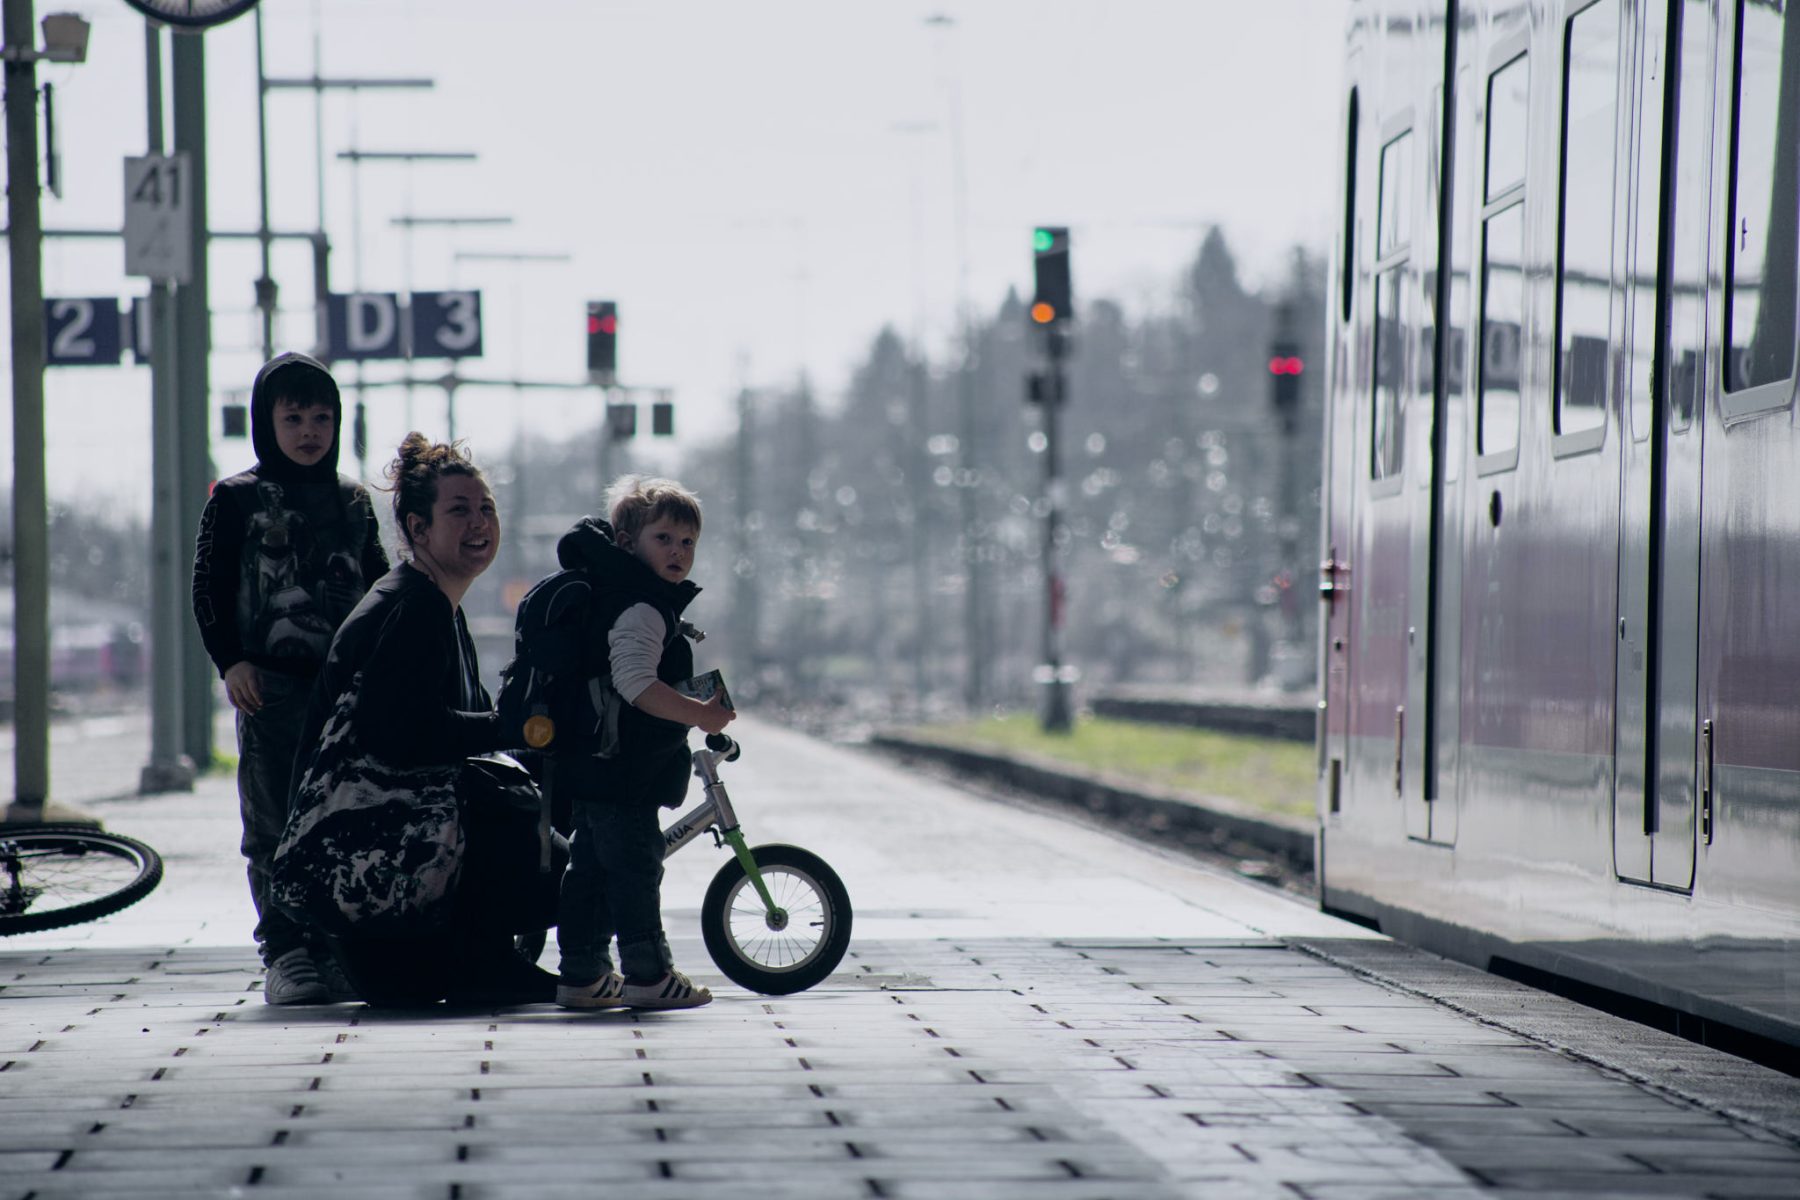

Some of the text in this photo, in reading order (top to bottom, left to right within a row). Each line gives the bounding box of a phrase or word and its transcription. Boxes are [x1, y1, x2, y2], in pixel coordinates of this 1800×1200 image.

[132, 162, 180, 210] 41
[52, 299, 96, 357] 2
[346, 292, 480, 351] D 3
